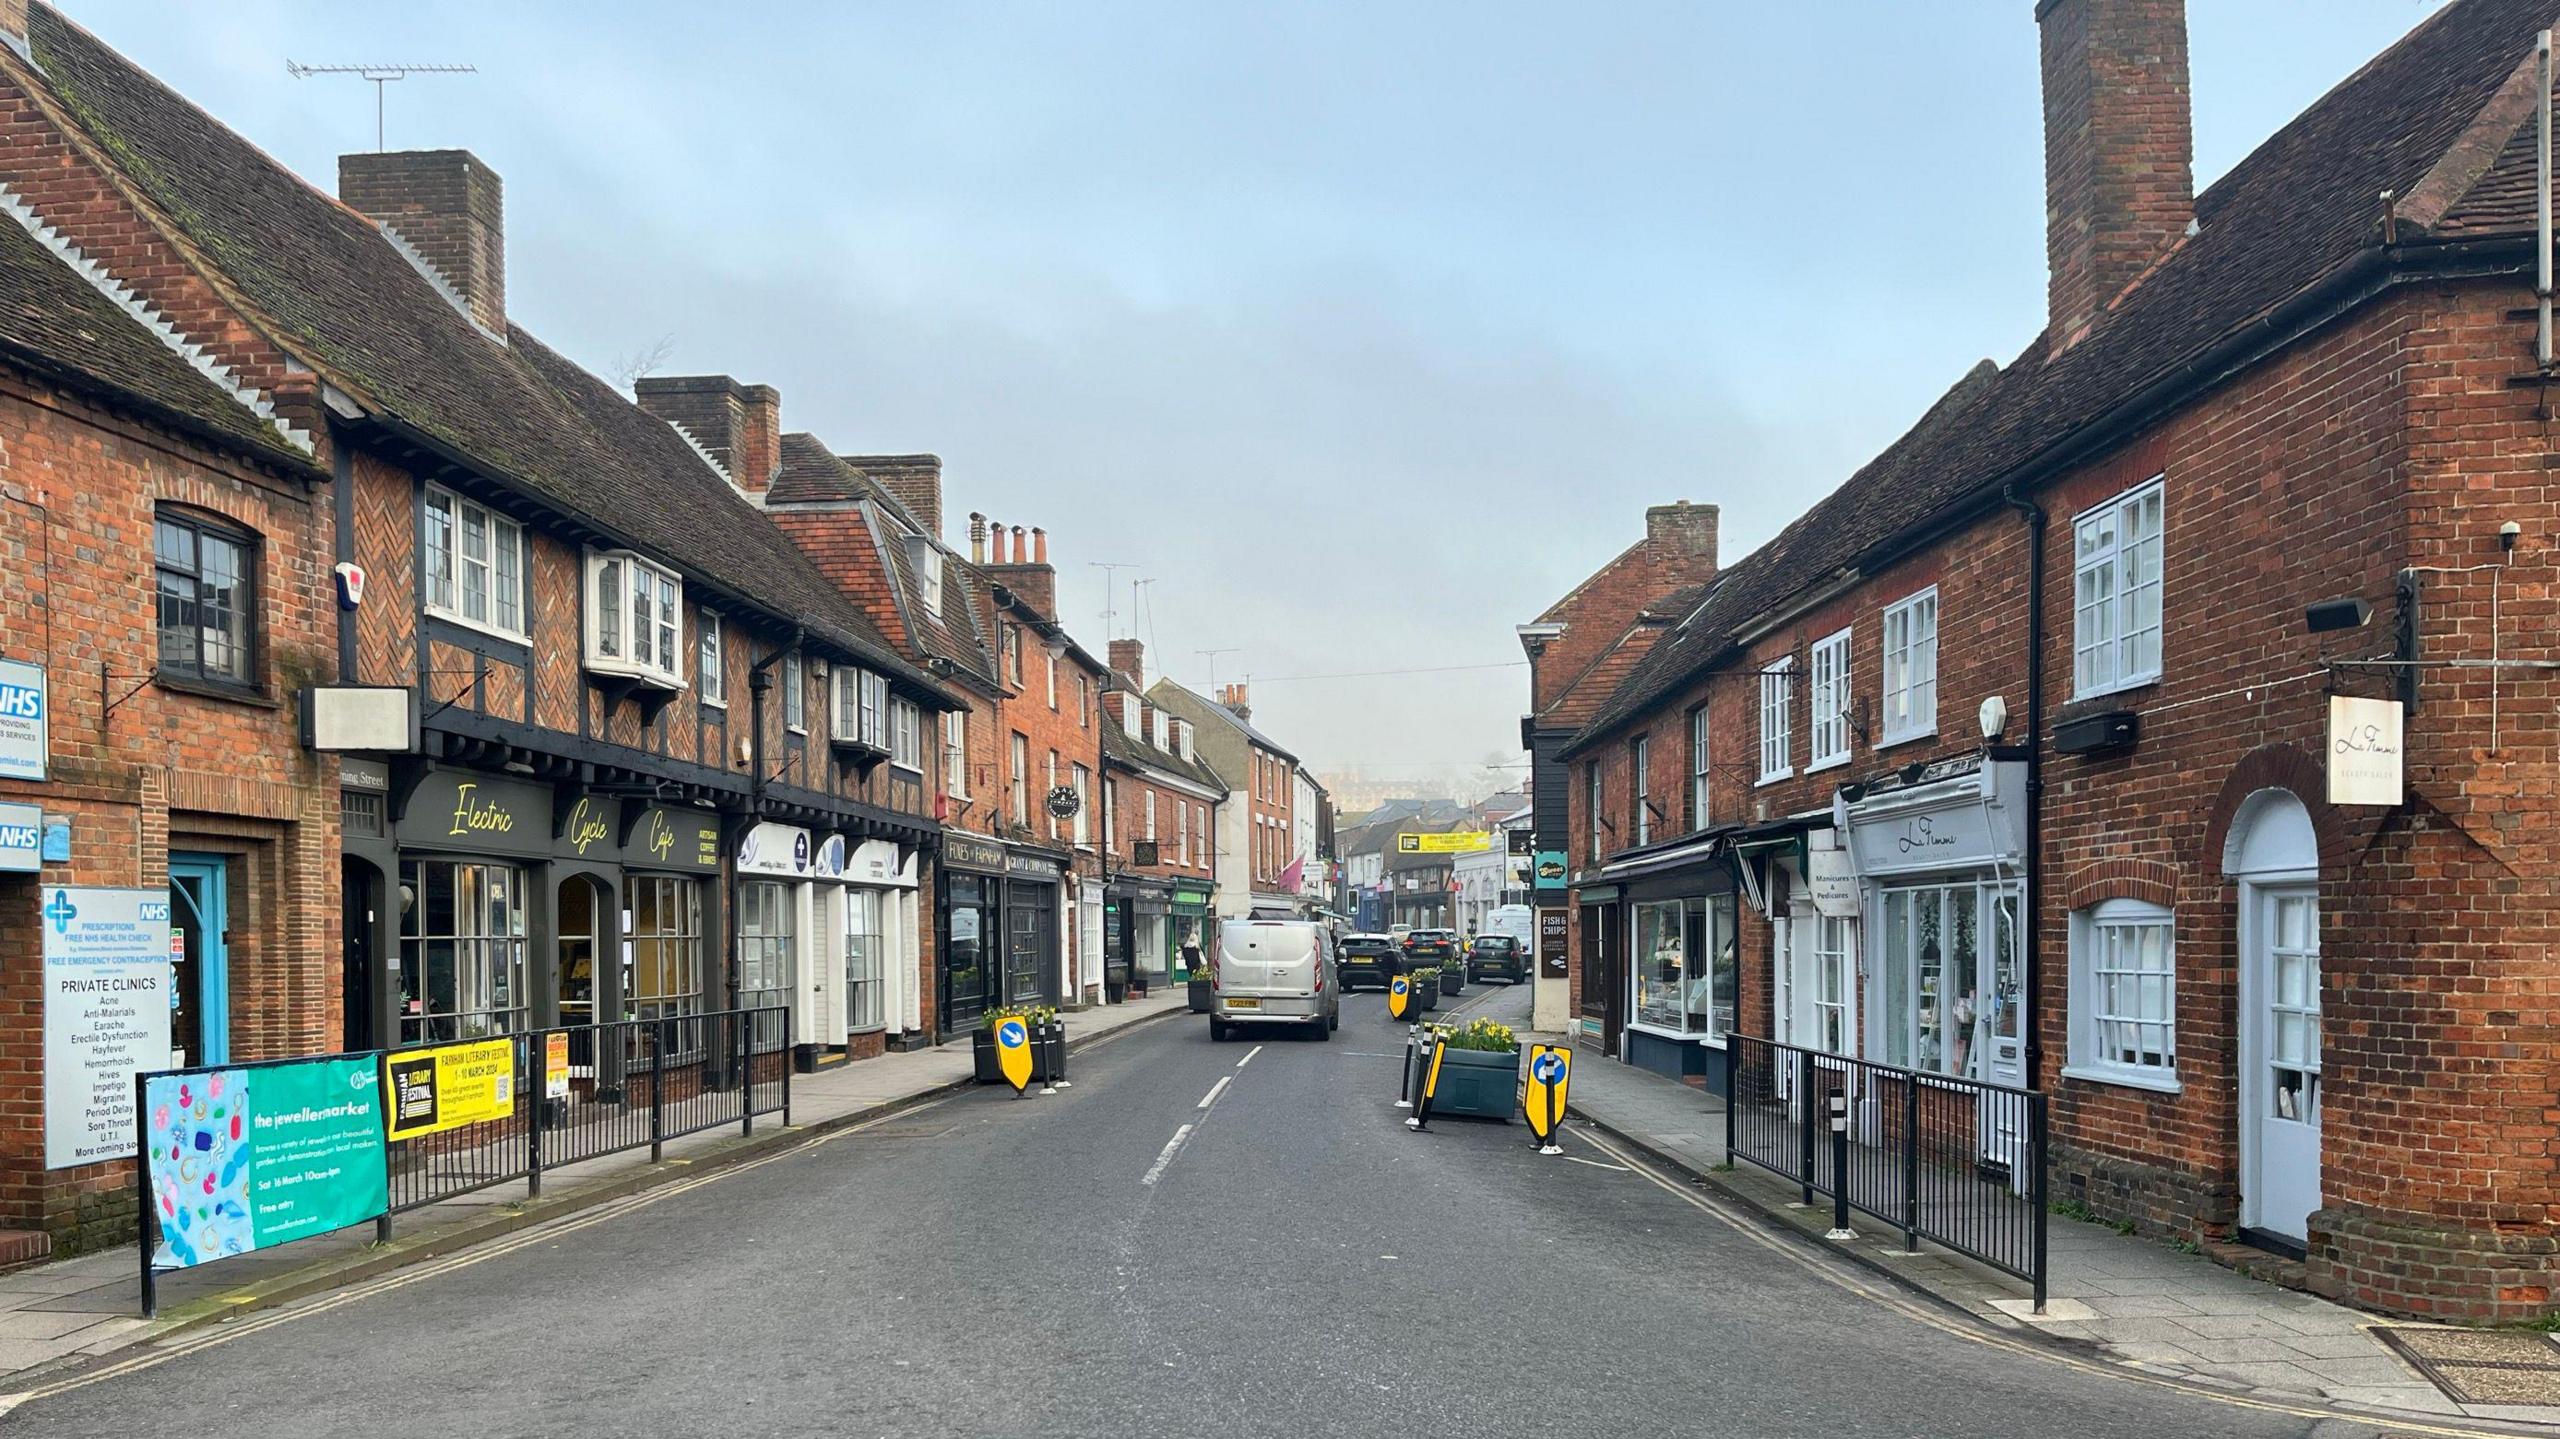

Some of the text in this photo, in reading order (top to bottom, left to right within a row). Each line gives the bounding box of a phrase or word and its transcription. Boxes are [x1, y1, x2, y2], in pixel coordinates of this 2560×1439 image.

[6, 730, 36, 742] SERVICES
[360, 771, 384, 786] Street
[449, 783, 513, 835] Electric
[571, 798, 608, 855] Cycle
[1, 828, 37, 848] NHS
[949, 841, 969, 861] FOXES
[975, 846, 1002, 866] FARNHAM
[141, 904, 168, 920] NHS
[82, 923, 135, 931] PRESCRIPTIONS
[1543, 916, 1567, 925] FISH &
[1543, 926, 1567, 935] CHIPS
[65, 934, 82, 942] FREE
[48, 955, 167, 965] FREE EMERGENCY CONTRACEPTION
[61, 978, 156, 993] PRIVATE CLINICS
[99, 996, 119, 1005] Acne
[84, 1007, 136, 1018] Anti-Malarials
[94, 1021, 125, 1031] Earache
[71, 1030, 148, 1044] Erectile Dysfunction
[92, 1045, 126, 1056] Hayfever
[85, 1057, 135, 1068] Hemorrhoids
[441, 1053, 465, 1067] FARNHAM
[465, 1049, 491, 1064] LITERARY
[99, 1071, 120, 1080] Hives
[408, 1068, 432, 1086] LITERARY
[468, 1065, 485, 1078] MARCH
[485, 1063, 498, 1076] 2024
[93, 1081, 126, 1092] Impetigo
[406, 1084, 433, 1102] FESTIVAL
[94, 1093, 126, 1105] Migraine
[86, 1104, 133, 1118] Period Delay
[88, 1118, 133, 1132] Sore Throat
[254, 1112, 273, 1128] the
[342, 1127, 375, 1138] beautiful
[75, 1146, 94, 1157] More
[96, 1142, 125, 1154] coming
[335, 1141, 351, 1152] local
[258, 1180, 272, 1191] Sat
[274, 1177, 282, 1188] 16
[282, 1172, 303, 1186] March
[259, 1200, 294, 1214] Free entry
